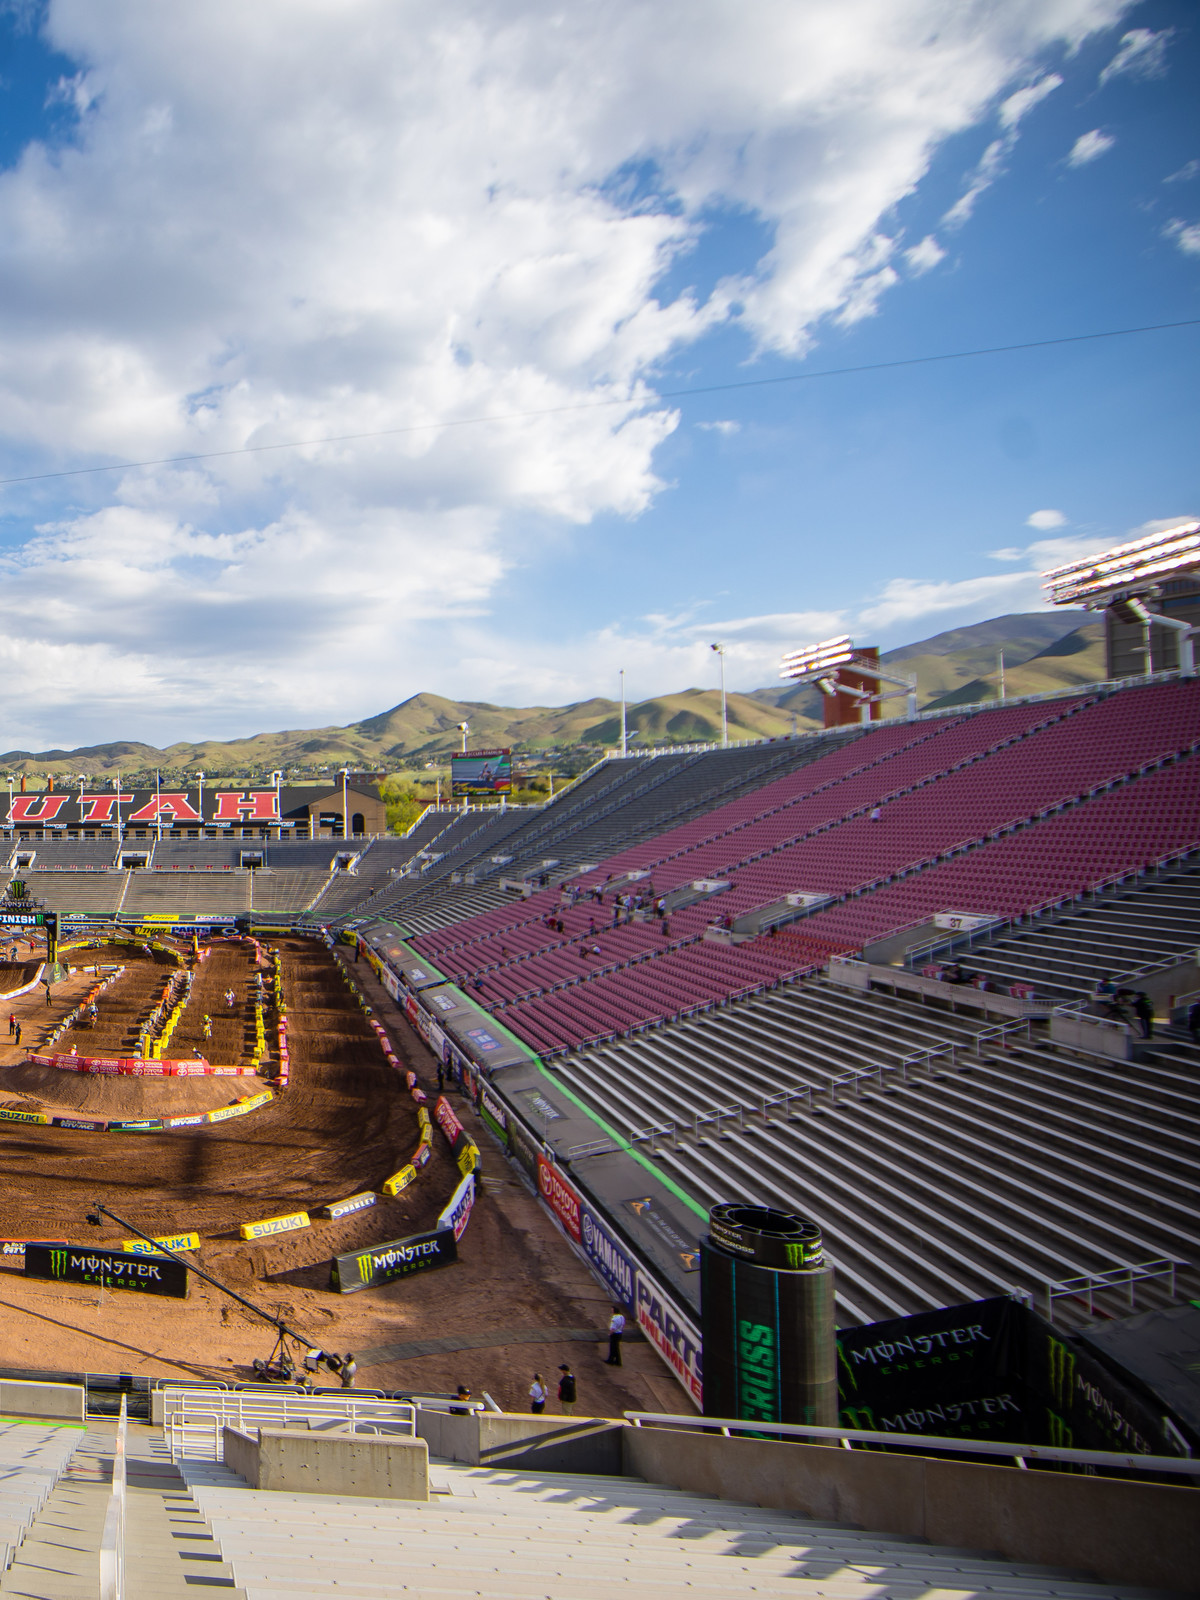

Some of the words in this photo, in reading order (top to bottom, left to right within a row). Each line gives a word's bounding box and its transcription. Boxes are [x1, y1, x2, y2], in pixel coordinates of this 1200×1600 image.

[6, 792, 280, 822] UTAH
[950, 918, 963, 928] 37
[213, 1105, 245, 1120] SUZUKI
[250, 1093, 270, 1107] SUZUKI
[0, 1110, 40, 1122] SUZUKI
[121, 1121, 150, 1129] Kawasaki
[394, 1167, 416, 1192] SUZUKI
[343, 1197, 375, 1213] OAKLEY
[451, 1185, 471, 1229] PARTS
[552, 1176, 579, 1222] TOYOTA
[252, 1216, 303, 1237] SUZUKI
[71, 1253, 162, 1280] MONSTER
[374, 1240, 440, 1269] MONSTER
[593, 1223, 633, 1297] YAMAHA
[386, 1259, 433, 1277] ENERGY
[586, 1244, 630, 1304] RACING
[84, 1274, 148, 1288] ENERGY
[638, 1304, 703, 1404] UNLIMITE
[851, 1324, 991, 1364] MONSTER
[881, 1350, 975, 1375] ENERGY
[881, 1394, 1021, 1432] MONSTER
